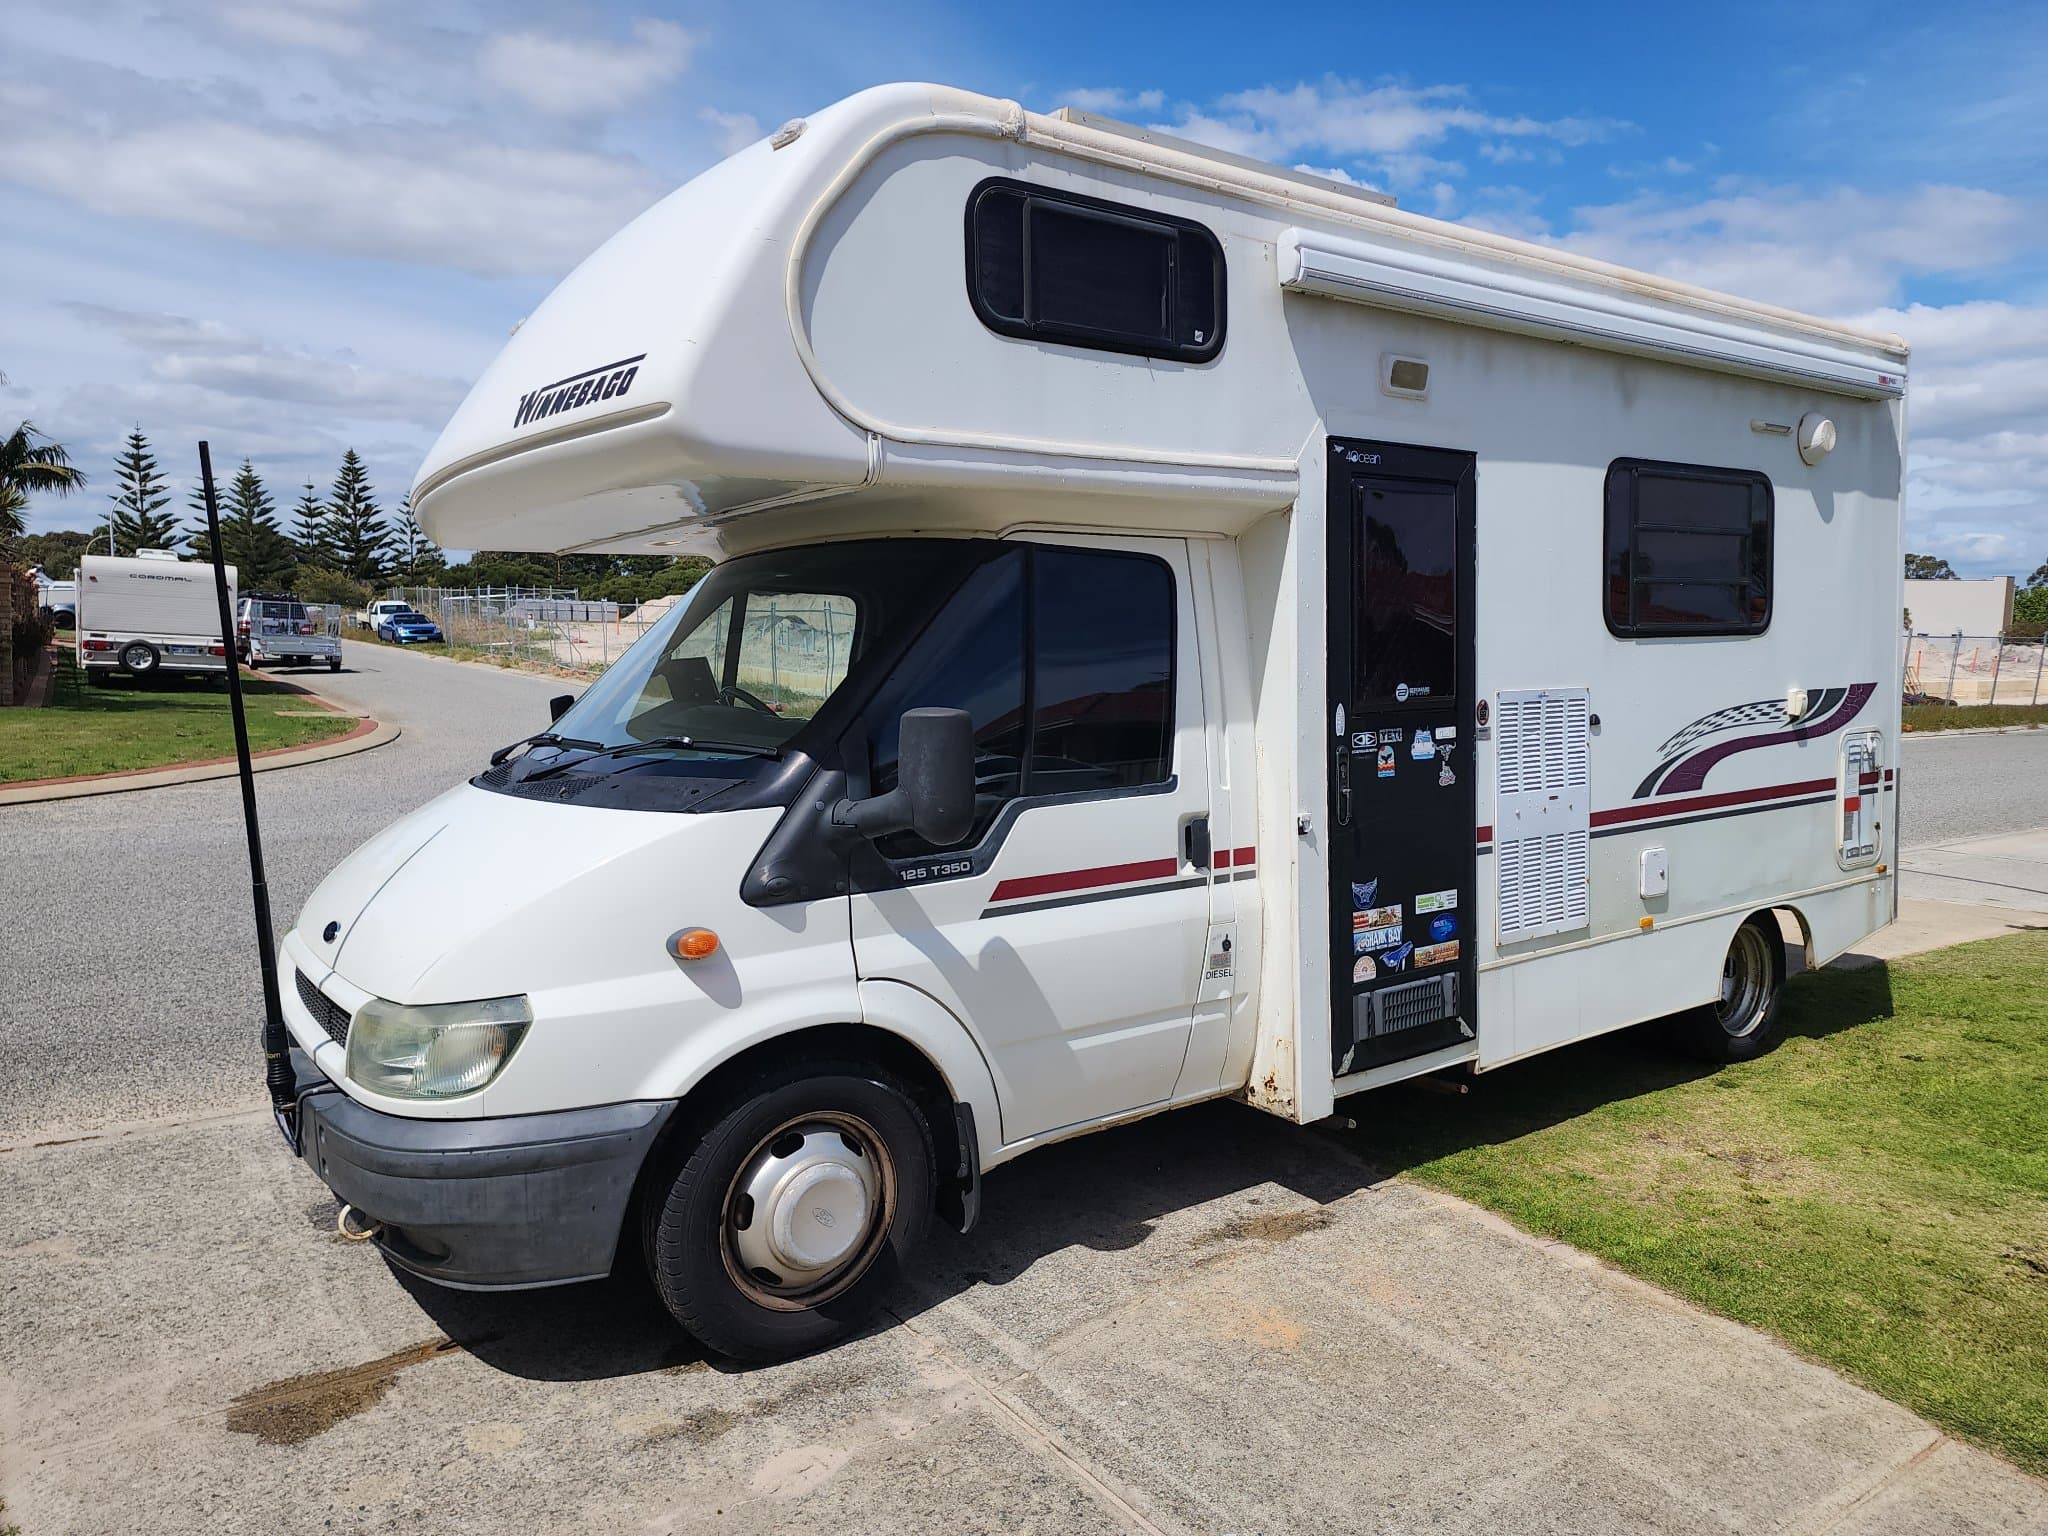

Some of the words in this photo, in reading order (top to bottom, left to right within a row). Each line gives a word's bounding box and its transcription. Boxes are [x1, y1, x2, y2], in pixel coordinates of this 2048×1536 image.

[513, 365, 639, 428] WINNEBAGO
[900, 867, 927, 881] 125
[931, 861, 970, 876] T350
[1388, 926, 1402, 943] BAY
[1206, 969, 1233, 980] DIESEL
